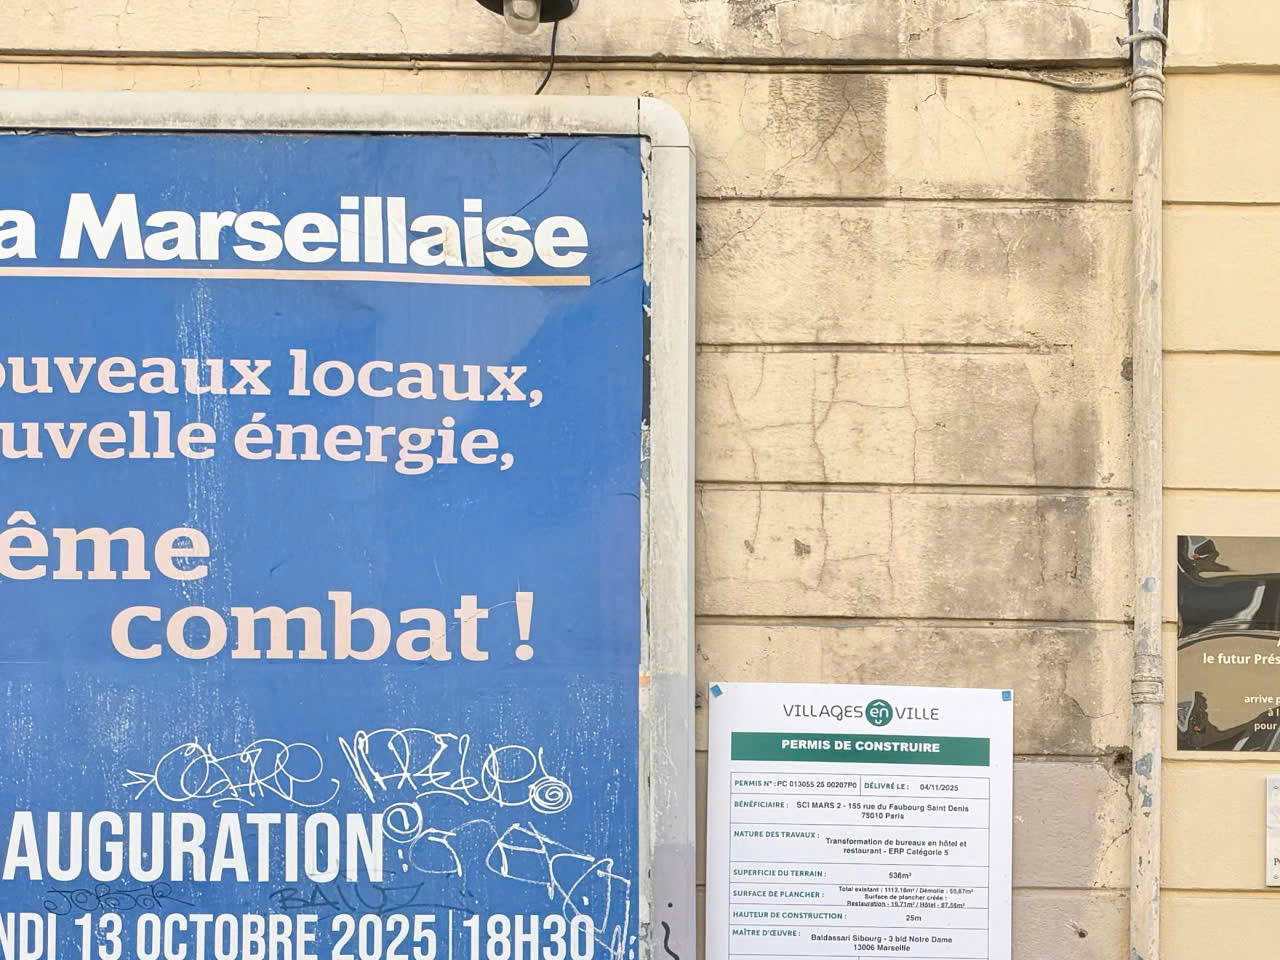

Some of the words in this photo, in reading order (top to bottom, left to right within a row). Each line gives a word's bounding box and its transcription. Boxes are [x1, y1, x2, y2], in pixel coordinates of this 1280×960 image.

[60, 192, 588, 268] Marseillaise
[288, 348, 543, 408] locaux,
[234, 413, 515, 475] énergie,
[110, 590, 489, 662] combat
[1203, 653, 1215, 664] le
[1217, 653, 1251, 664] futur
[1244, 695, 1273, 704] arrive
[783, 704, 863, 721] VILLAGES
[895, 707, 939, 720] VILLE
[1267, 708, 1274, 718] à
[1254, 723, 1277, 733] pour
[781, 739, 831, 749] PERMIS
[834, 740, 852, 750] DE
[855, 741, 940, 752] CONSTRUIRE
[864, 780, 895, 789] DÉLIVRÉ
[920, 783, 959, 791] 04/11/2025
[734, 800, 785, 808] BÉNÉFICIAIRE
[796, 801, 810, 809] SCI
[812, 801, 835, 809] MARS
[889, 804, 925, 812] Faubourg
[927, 804, 946, 812] Saint
[734, 830, 764, 838] NATURE
[2, 811, 385, 883] AUGURATION
[826, 837, 882, 846] Transformation
[939, 839, 957, 847] hôtel
[906, 848, 942, 856] Catégorie
[777, 869, 789, 877] DU
[732, 928, 761, 936] MAÎTRE
[852, 935, 882, 943] Sibourg
[877, 944, 910, 952] Marseille
